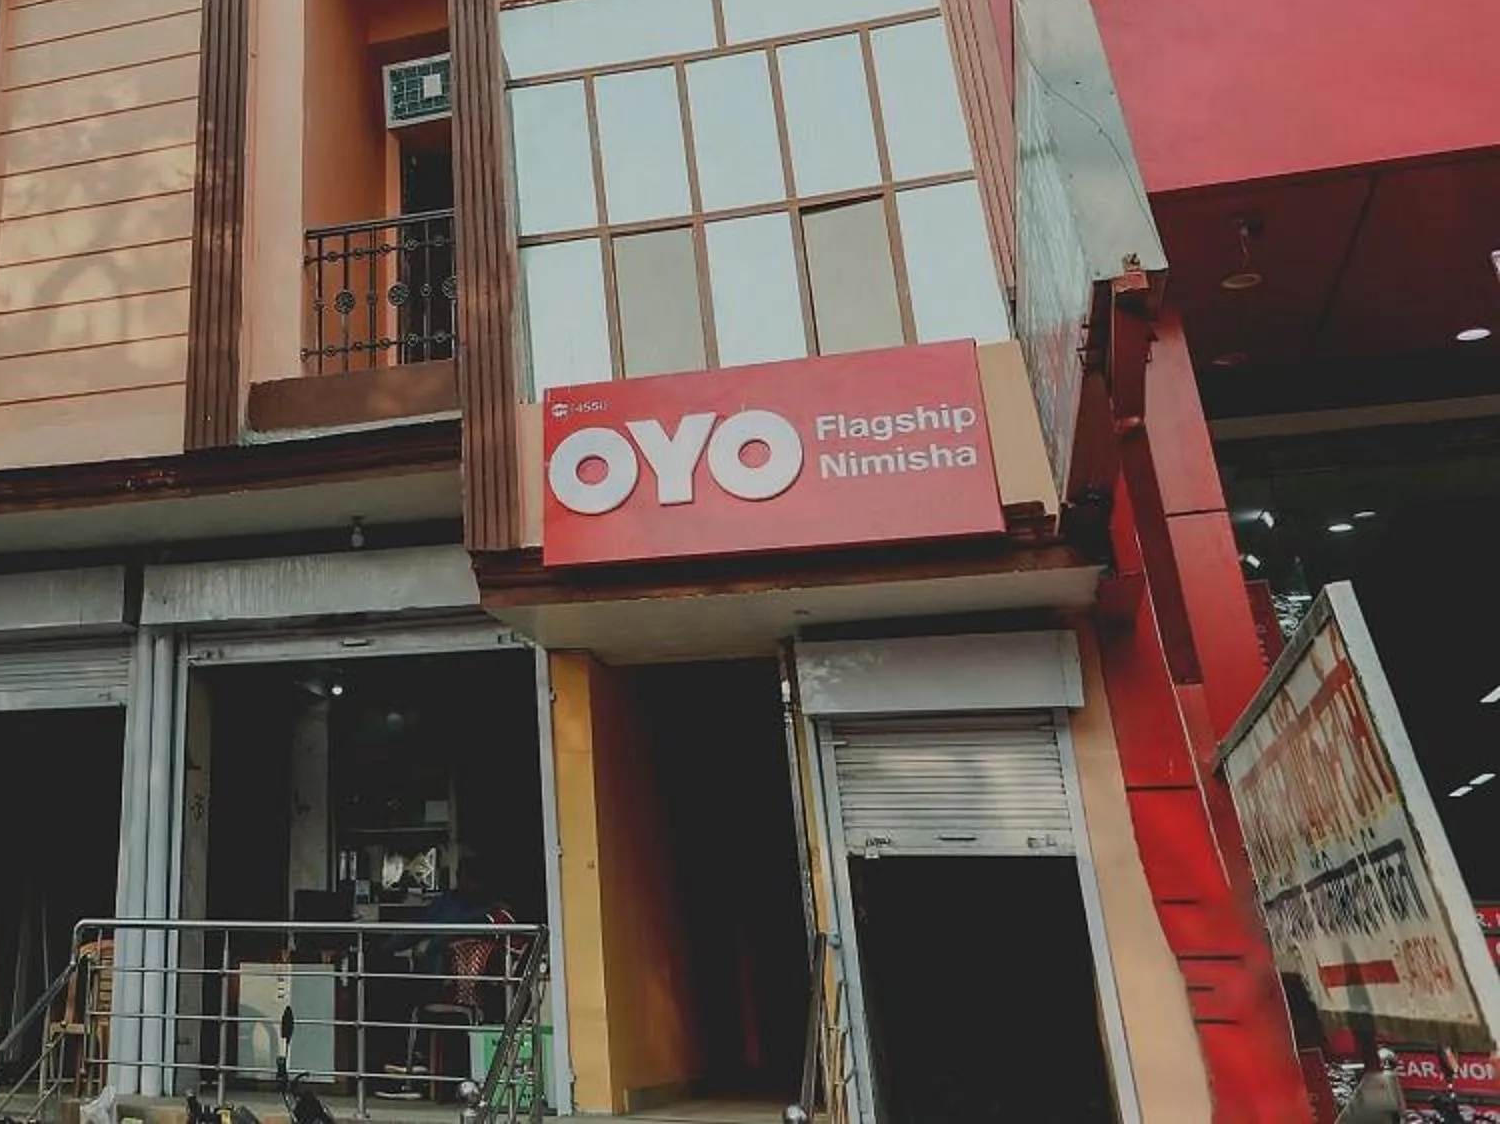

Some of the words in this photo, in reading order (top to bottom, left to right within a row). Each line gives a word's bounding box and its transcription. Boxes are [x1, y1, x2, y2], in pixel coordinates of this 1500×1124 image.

[816, 403, 977, 441] Flagship
[548, 409, 804, 515] OYO
[819, 443, 977, 479] Nimisha
[1393, 1060, 1445, 1082] EAR,
